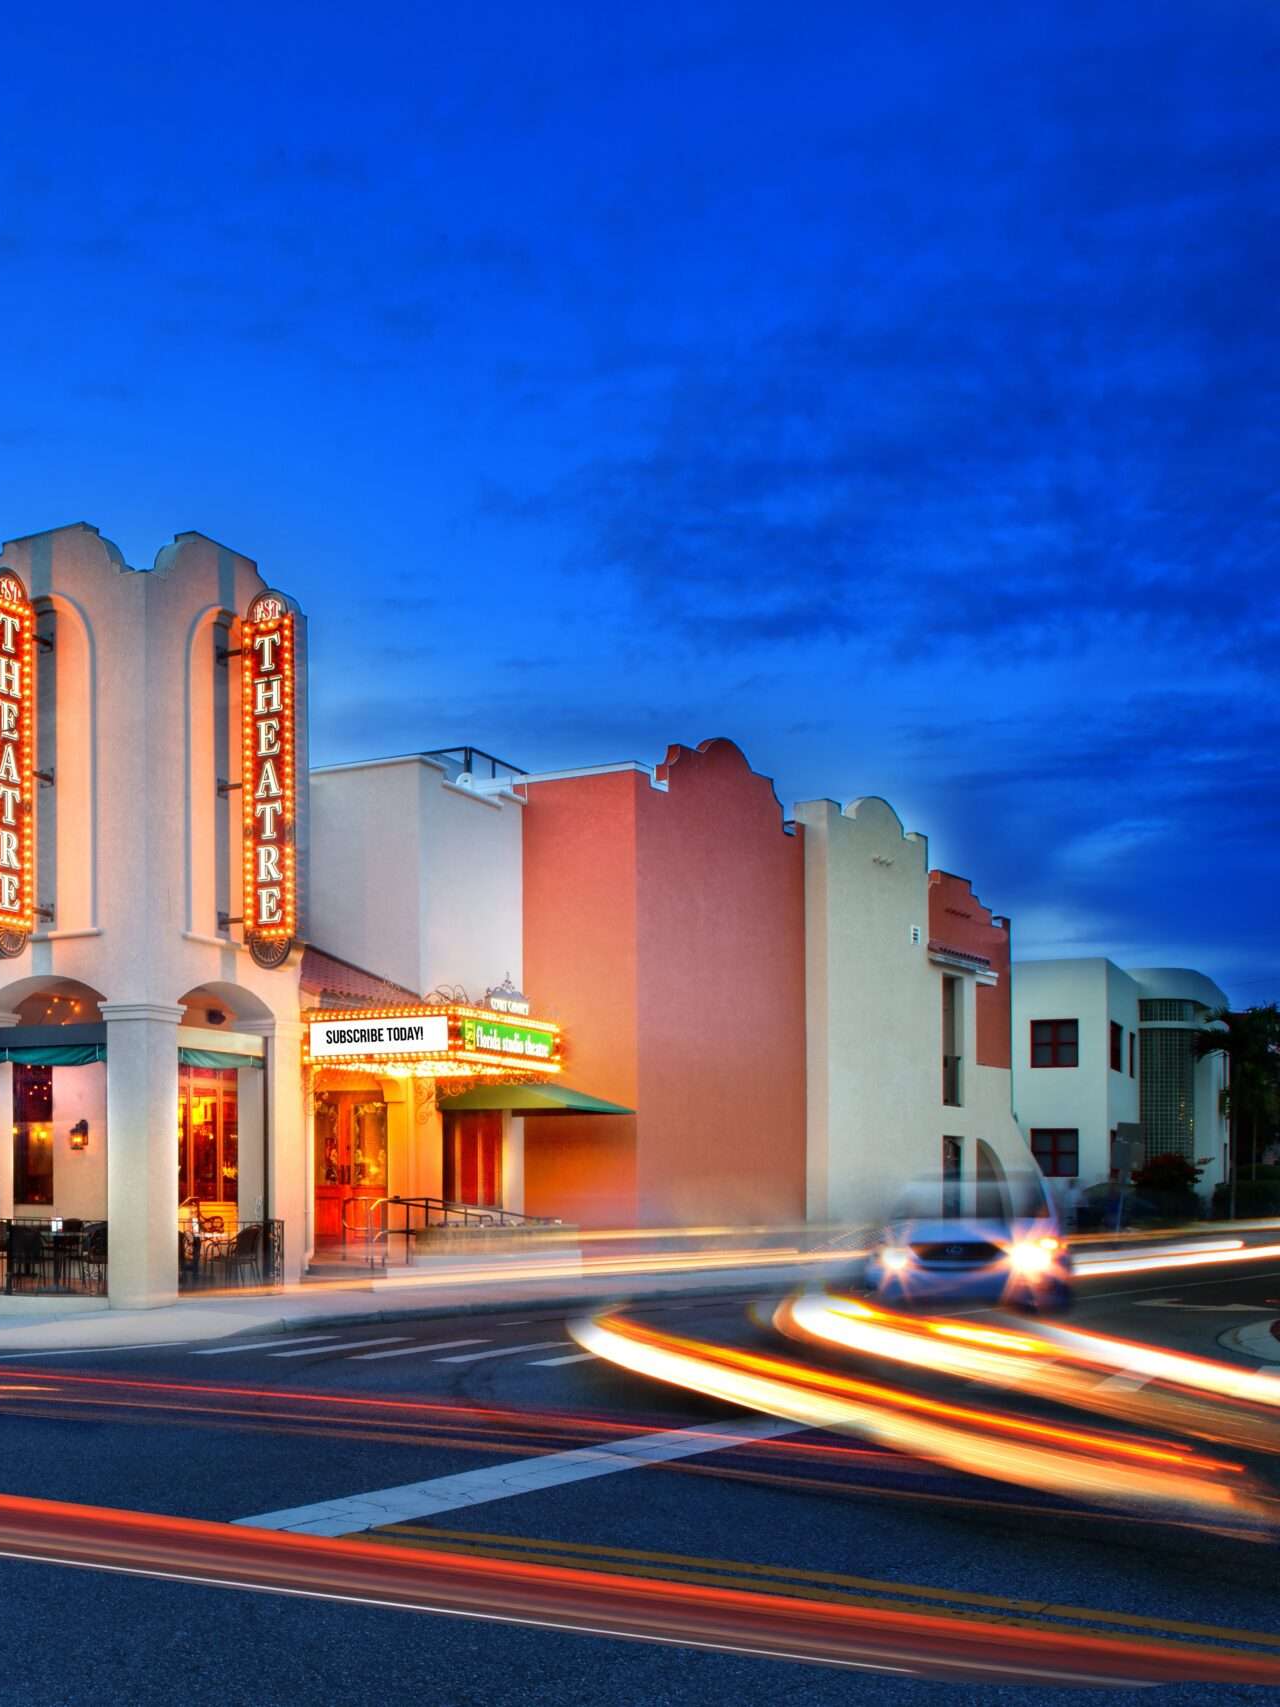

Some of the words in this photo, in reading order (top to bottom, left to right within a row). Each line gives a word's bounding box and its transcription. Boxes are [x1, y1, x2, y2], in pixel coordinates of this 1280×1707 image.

[253, 599, 280, 623] FST
[253, 631, 283, 925] THEATRE
[326, 1028, 384, 1044] SUBSCRIBE
[387, 1026, 424, 1042] TODAY!
